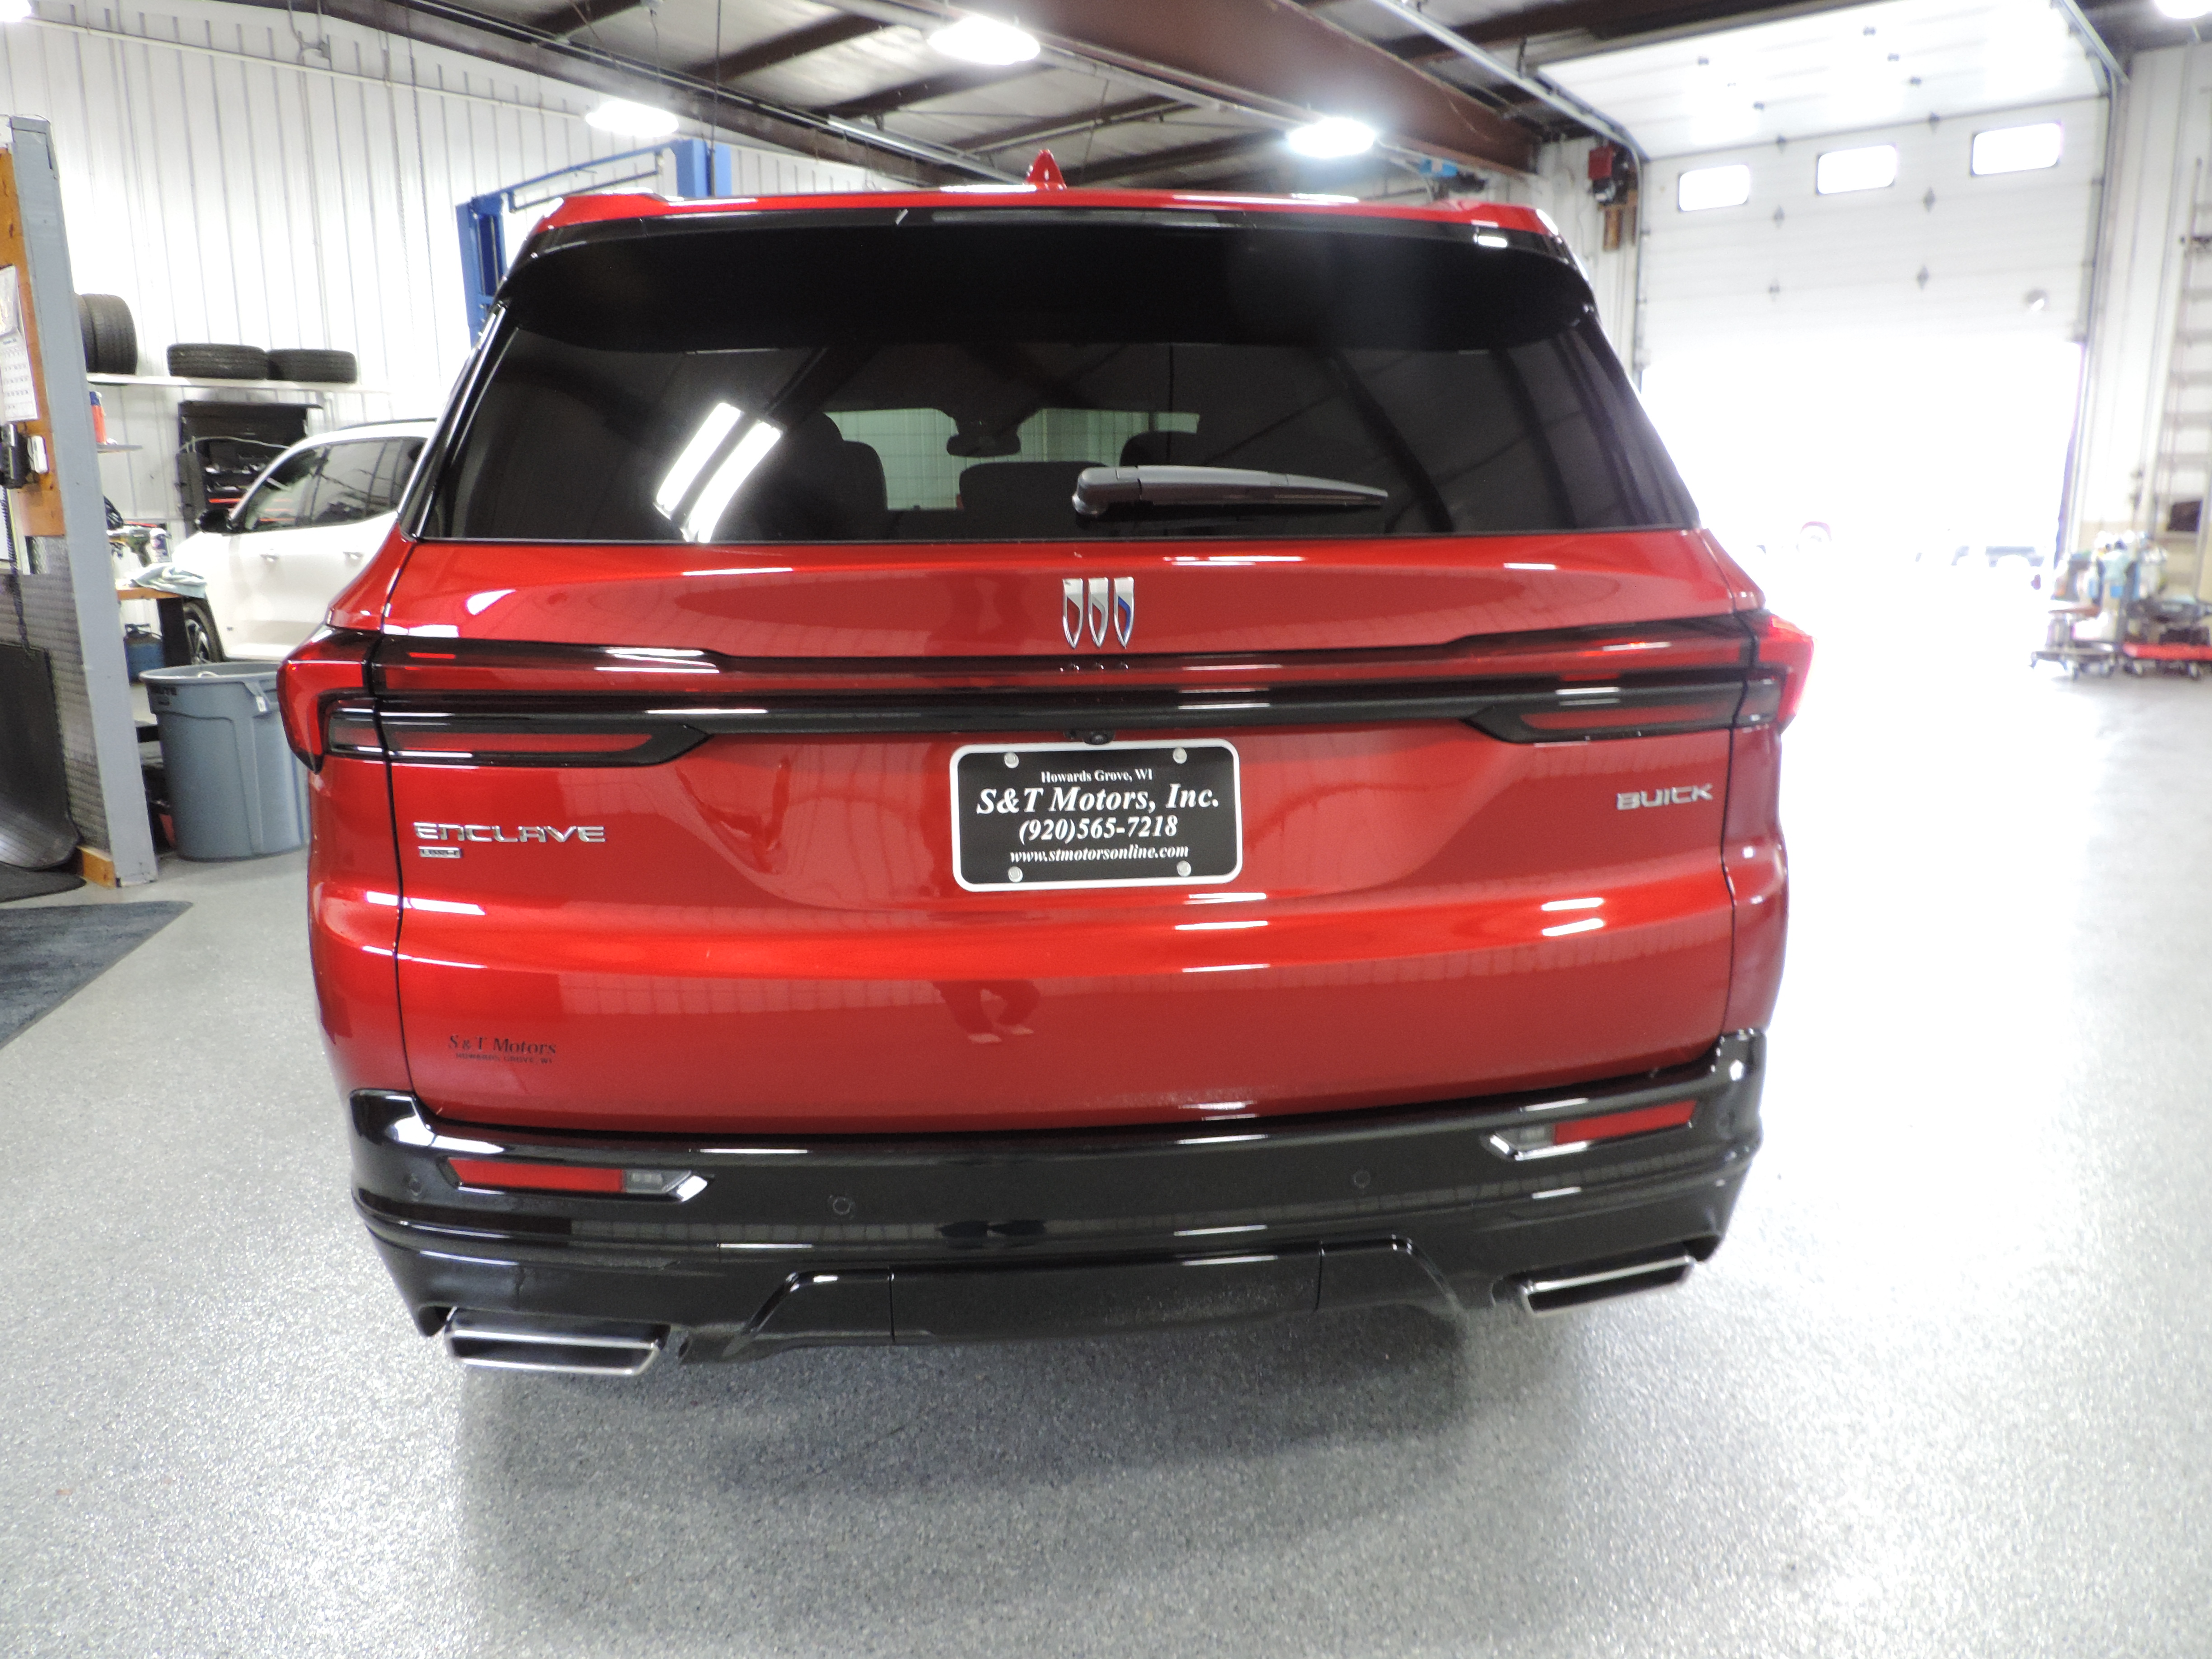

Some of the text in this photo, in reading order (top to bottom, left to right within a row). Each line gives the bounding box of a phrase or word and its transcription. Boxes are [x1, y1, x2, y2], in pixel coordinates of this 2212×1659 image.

[1041, 768, 1153, 783] Howards Grove, WI
[976, 783, 1219, 814] S&T Motors, Inc.
[1616, 783, 1713, 810] BUICK
[413, 822, 605, 843] ENCLAVE
[1019, 815, 1178, 845] (920)565-7218
[1010, 844, 1190, 863] www.stmotorsonline.com
[449, 1035, 459, 1049] S
[462, 1040, 471, 1050] &
[493, 1038, 556, 1054] Motors
